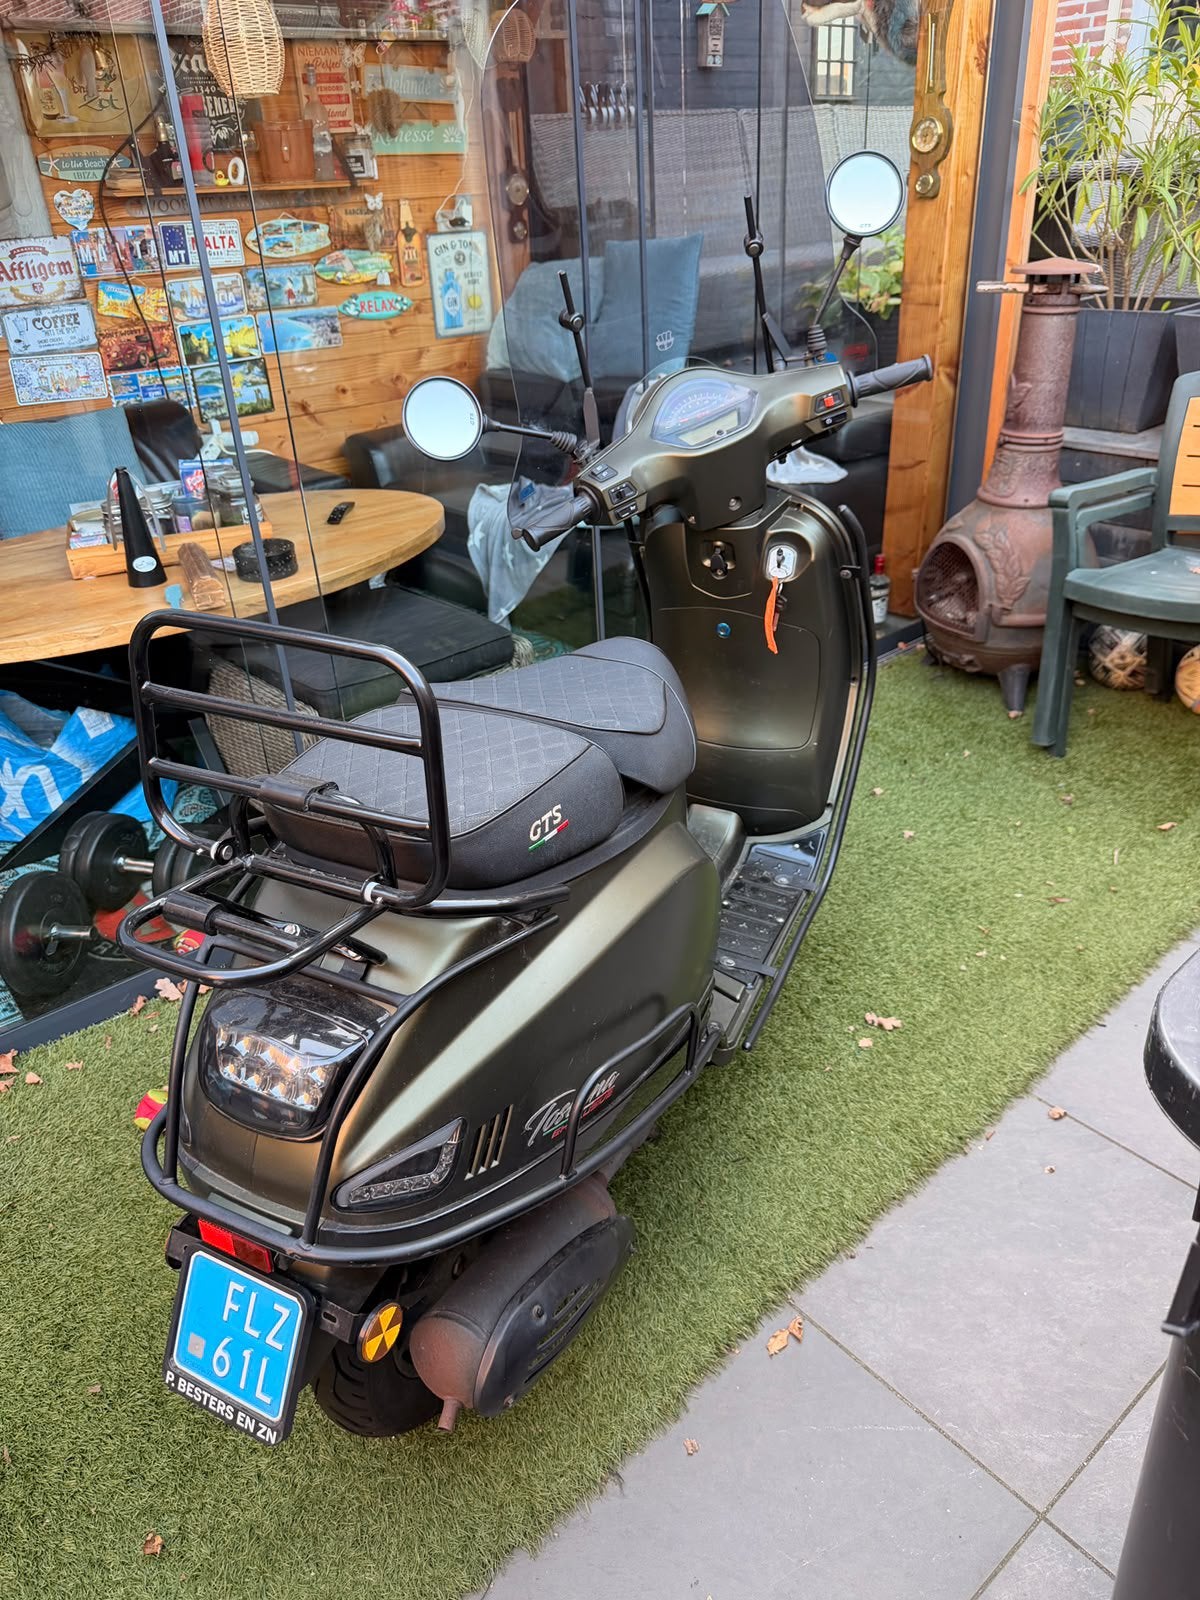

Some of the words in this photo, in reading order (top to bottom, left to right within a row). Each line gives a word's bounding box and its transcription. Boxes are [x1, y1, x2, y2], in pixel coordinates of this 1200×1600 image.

[61, 161, 70, 169] to
[70, 160, 82, 168] the
[84, 158, 106, 168] Beach
[73, 171, 98, 180] IBIZA
[168, 250, 187, 264] MT
[0, 258, 73, 282] Affligem
[359, 298, 398, 314] RELAX
[32, 312, 80, 331] COFFEE
[529, 804, 562, 842] GTS
[222, 1281, 291, 1351] FLZ
[212, 1336, 273, 1405] 61L
[165, 1370, 176, 1388] P.
[177, 1377, 235, 1419] BESTERS
[236, 1414, 255, 1432] EN
[256, 1425, 278, 1444] ZN
